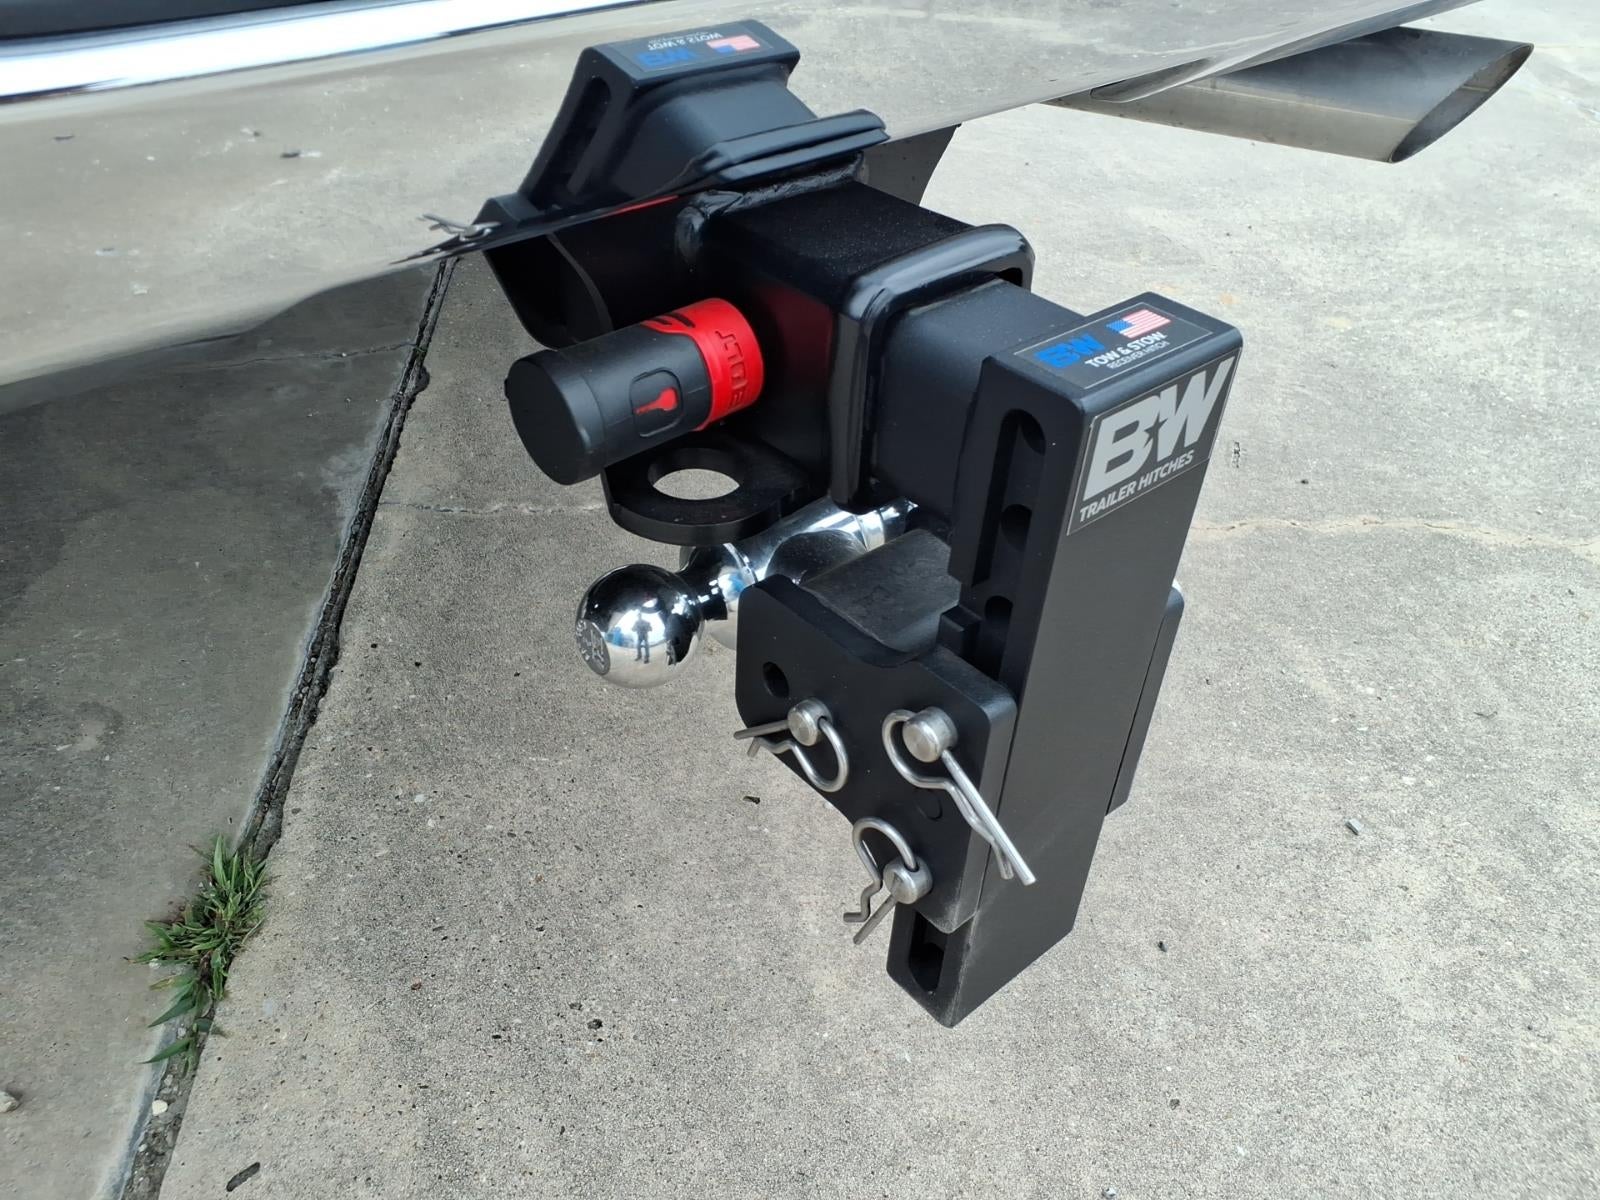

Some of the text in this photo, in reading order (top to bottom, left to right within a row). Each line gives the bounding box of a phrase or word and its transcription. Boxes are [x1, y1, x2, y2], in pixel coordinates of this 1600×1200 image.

[1084, 350, 1120, 368] TOW
[1119, 346, 1132, 356] &
[1106, 341, 1171, 370] RECEIVER HITCH
[1080, 450, 1194, 521] TRAILER HITCHES
